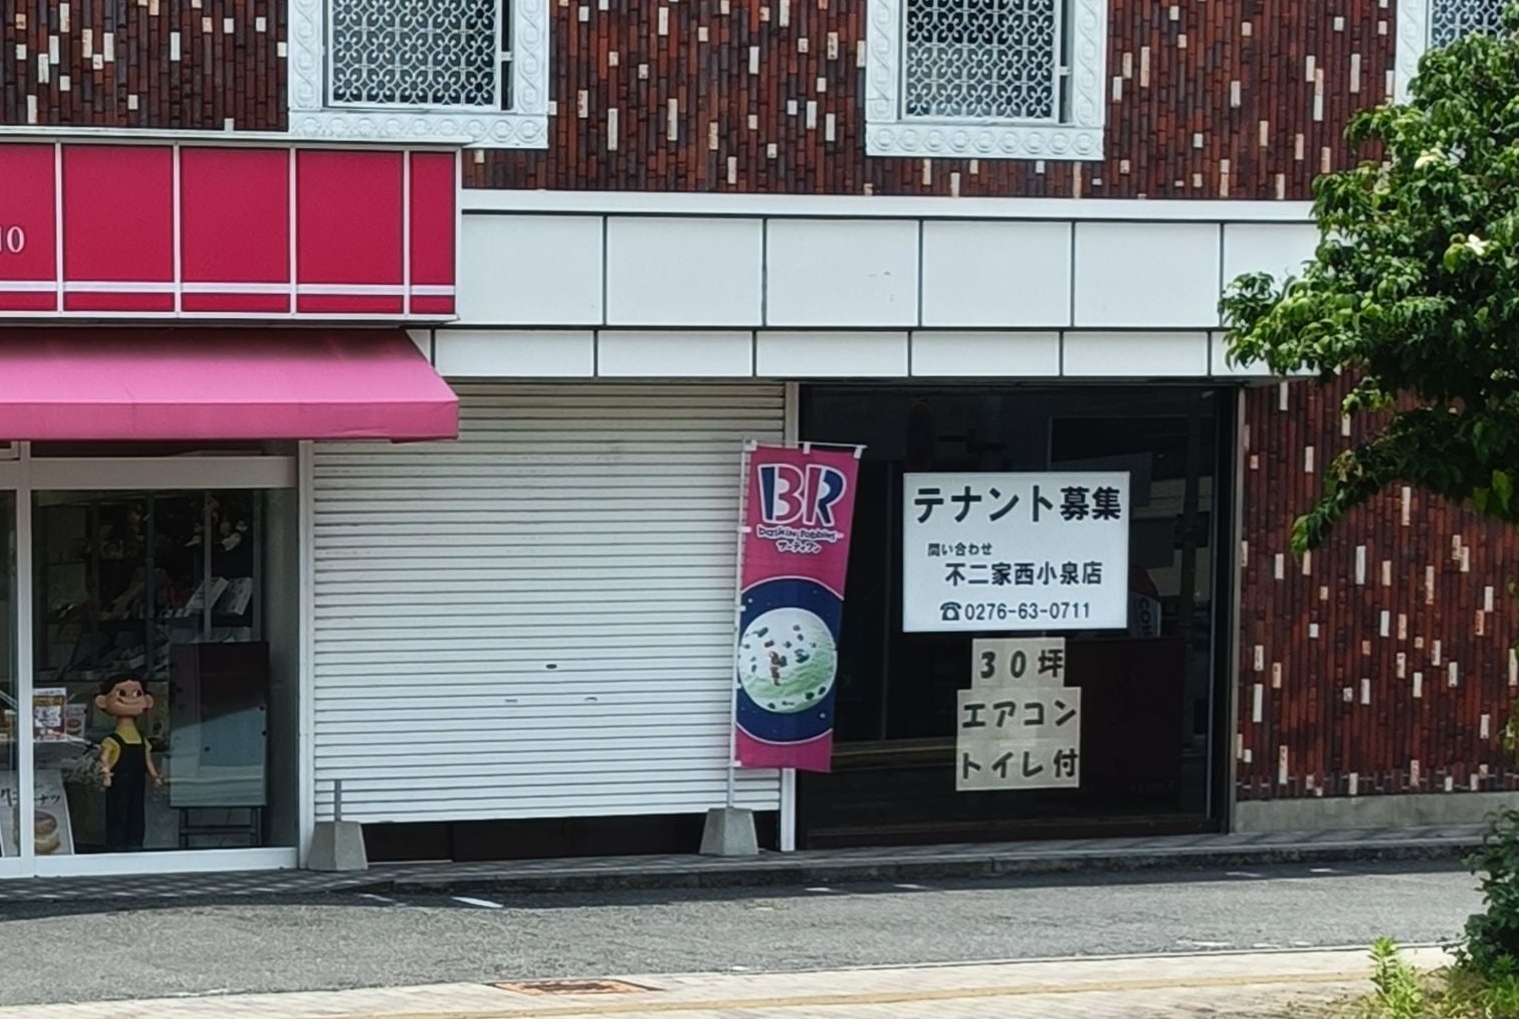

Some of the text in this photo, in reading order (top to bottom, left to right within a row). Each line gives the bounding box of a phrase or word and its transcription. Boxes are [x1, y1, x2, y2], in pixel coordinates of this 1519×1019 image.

[757, 463, 848, 526] BR
[914, 485, 1122, 523] テナント募集
[927, 543, 994, 558] 問い合わせ
[945, 561, 1103, 586] 不二家西小泉店
[964, 602, 1091, 621] 0276-63-0711
[962, 701, 1077, 728] エアコン
[962, 748, 1078, 780] トイレ付
